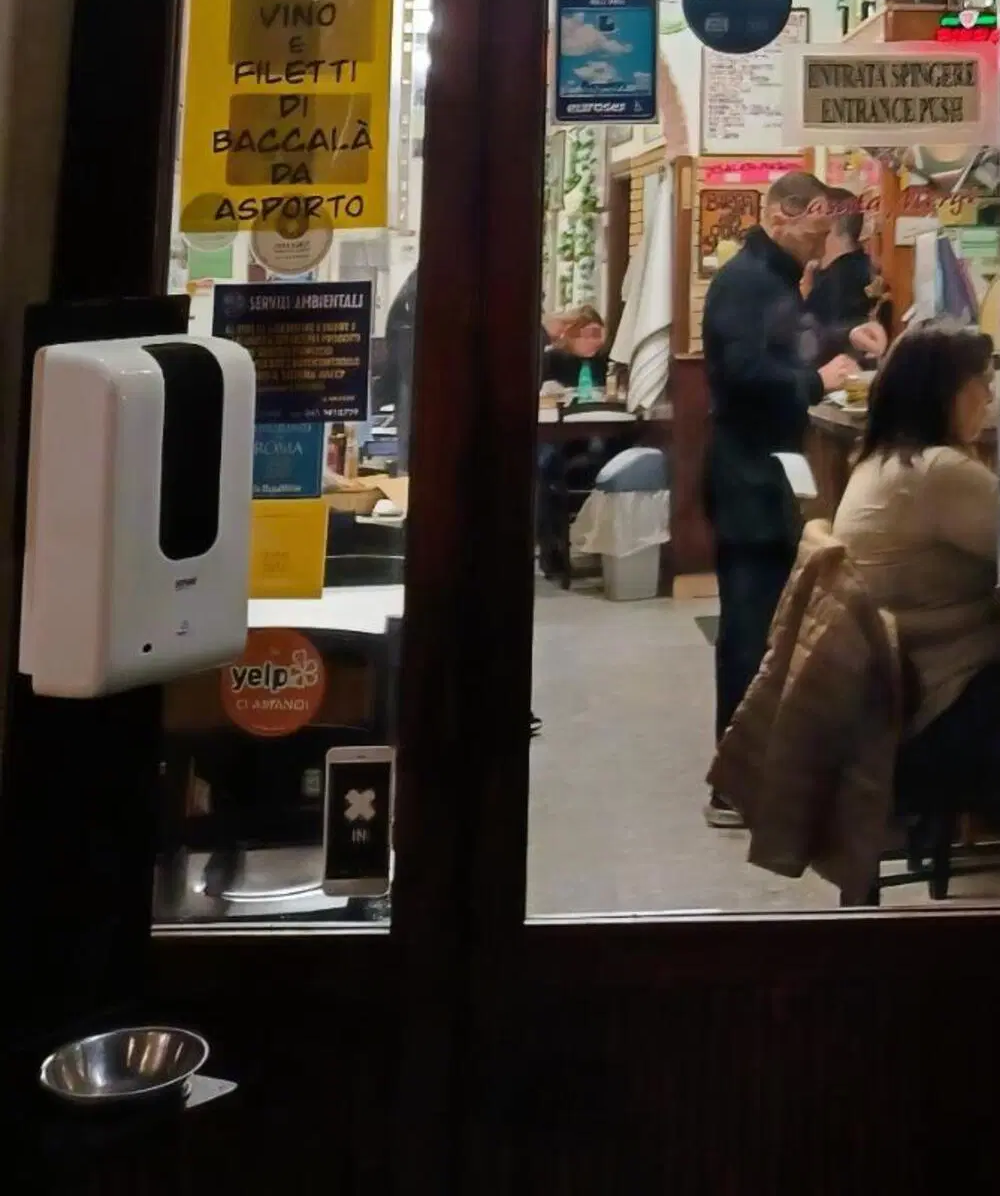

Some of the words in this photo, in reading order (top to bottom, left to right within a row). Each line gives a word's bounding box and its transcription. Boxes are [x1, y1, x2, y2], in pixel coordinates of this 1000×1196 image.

[260, 2, 337, 29] VINO
[289, 35, 305, 53] E
[234, 59, 356, 84] FILETTI
[808, 63, 886, 89] ENTRATA
[891, 61, 975, 88] SPINGERE
[279, 94, 307, 118] DI
[821, 96, 916, 123] ENTRANCE
[919, 96, 964, 122] PUSH
[213, 120, 373, 154] BACCALÀ
[271, 163, 313, 185] DA
[214, 195, 364, 221] ASPORTO
[231, 661, 288, 691] yelp
[351, 829, 367, 844] IN
